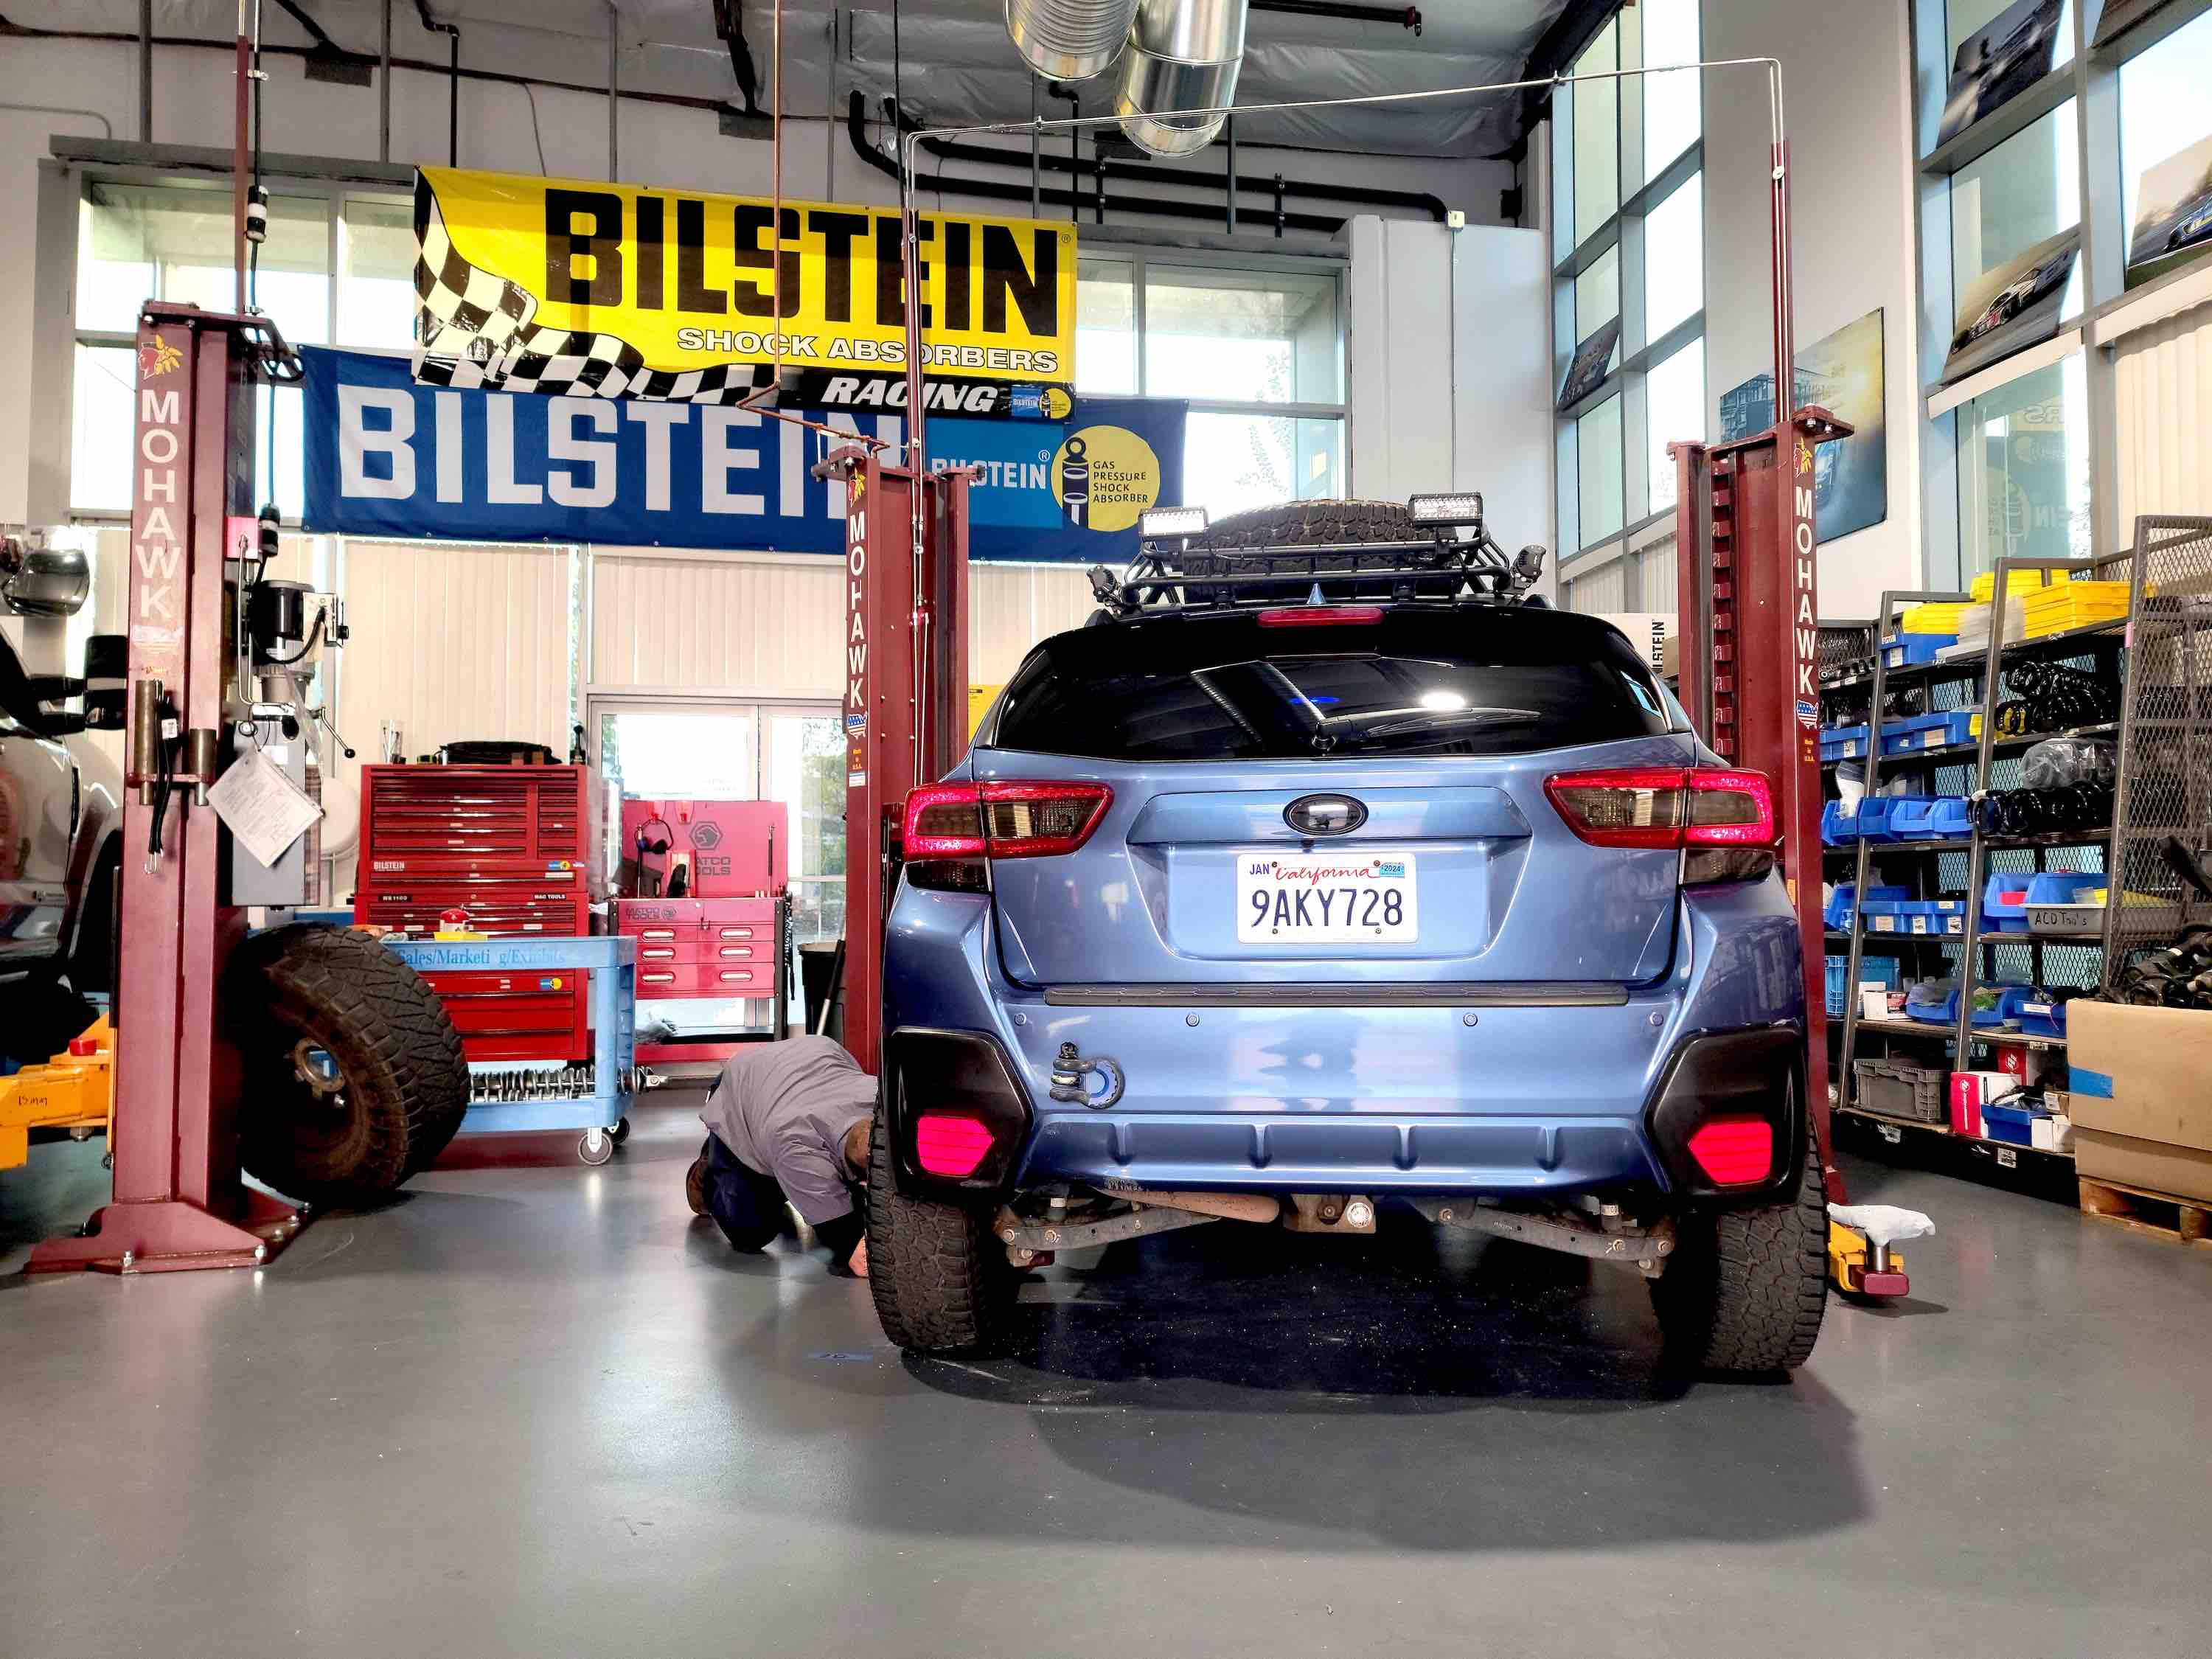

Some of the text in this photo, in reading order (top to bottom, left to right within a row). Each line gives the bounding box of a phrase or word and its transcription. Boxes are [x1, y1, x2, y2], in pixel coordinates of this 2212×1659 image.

[545, 188, 1057, 337] BILSTEIN
[677, 327, 818, 358] SHOCK
[821, 377, 998, 412] RACING
[1093, 460, 1115, 470] GAS
[1093, 471, 1147, 481] PRESSURE
[1093, 482, 1130, 492] SHOCK
[1093, 493, 1149, 504] ABSORBER
[136, 389, 181, 619] MOHAWK
[1795, 485, 1817, 696] MOHAWK
[848, 511, 867, 709] MOHAWK
[696, 856, 731, 866] ATCO
[1249, 863, 1402, 886] JAN California 2024
[1251, 888, 1402, 928] 9AKY728
